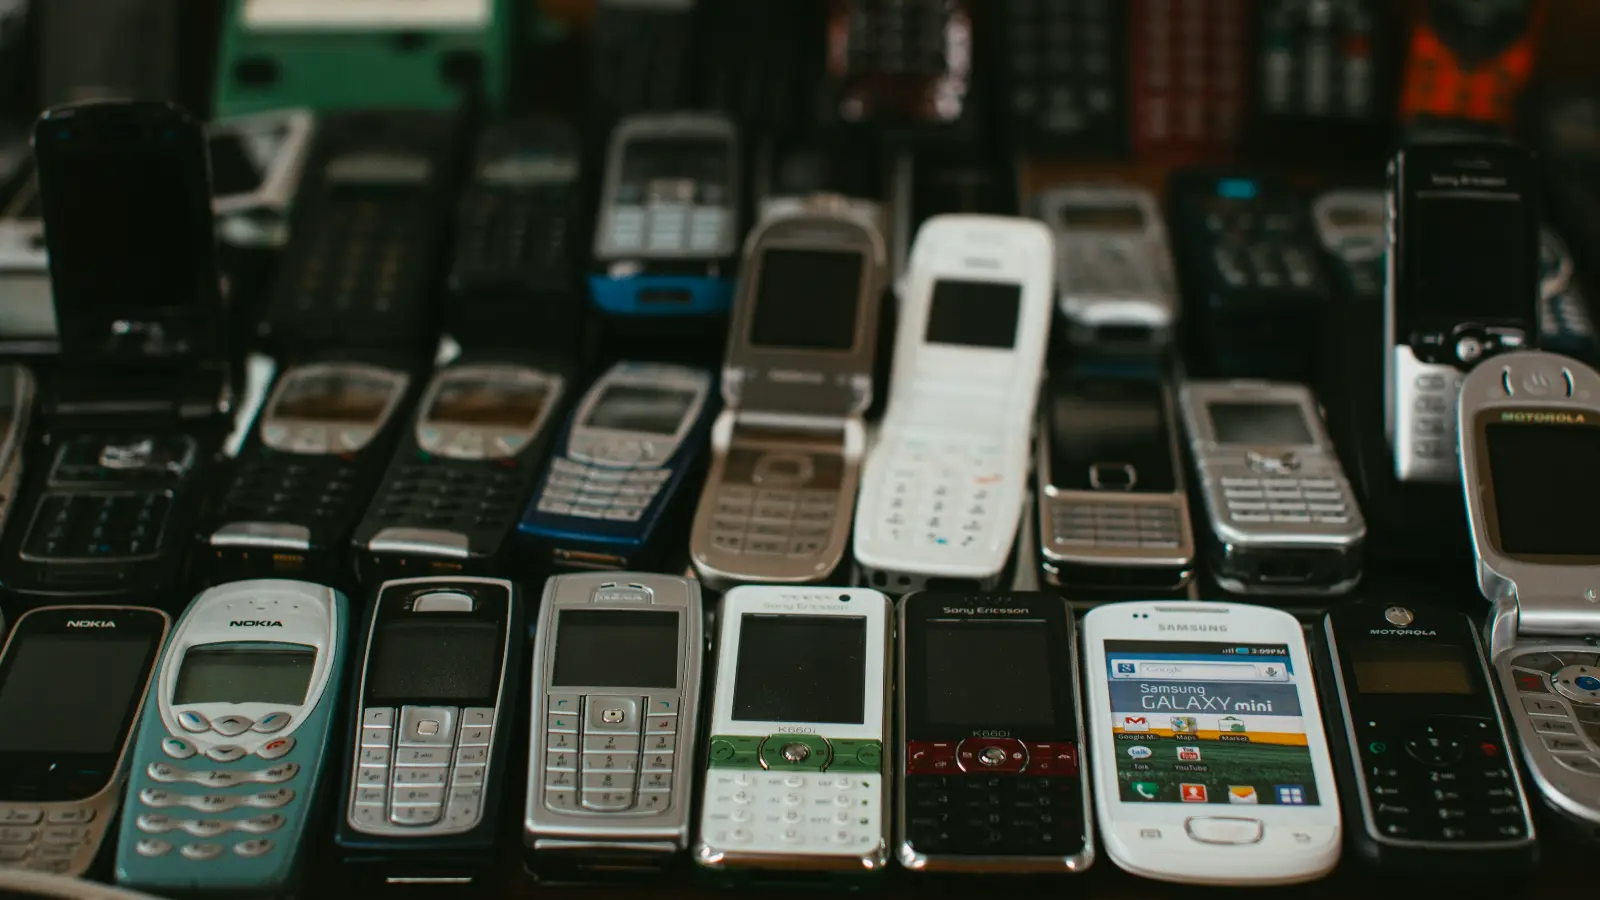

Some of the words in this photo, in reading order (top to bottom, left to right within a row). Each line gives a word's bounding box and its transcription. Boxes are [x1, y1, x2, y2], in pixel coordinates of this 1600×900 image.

[1501, 412, 1585, 423] MOTOROLA
[763, 602, 794, 611] Sony
[943, 606, 974, 615] Sony
[977, 606, 1029, 614] Ericsson
[66, 620, 116, 628] NOKIA
[1158, 623, 1228, 632] SAMSUNG
[1146, 665, 1182, 674] Google
[1140, 683, 1205, 696] Samsung
[1141, 695, 1231, 711] GALAXY
[1234, 700, 1273, 712] mini
[972, 729, 1010, 737] K660i
